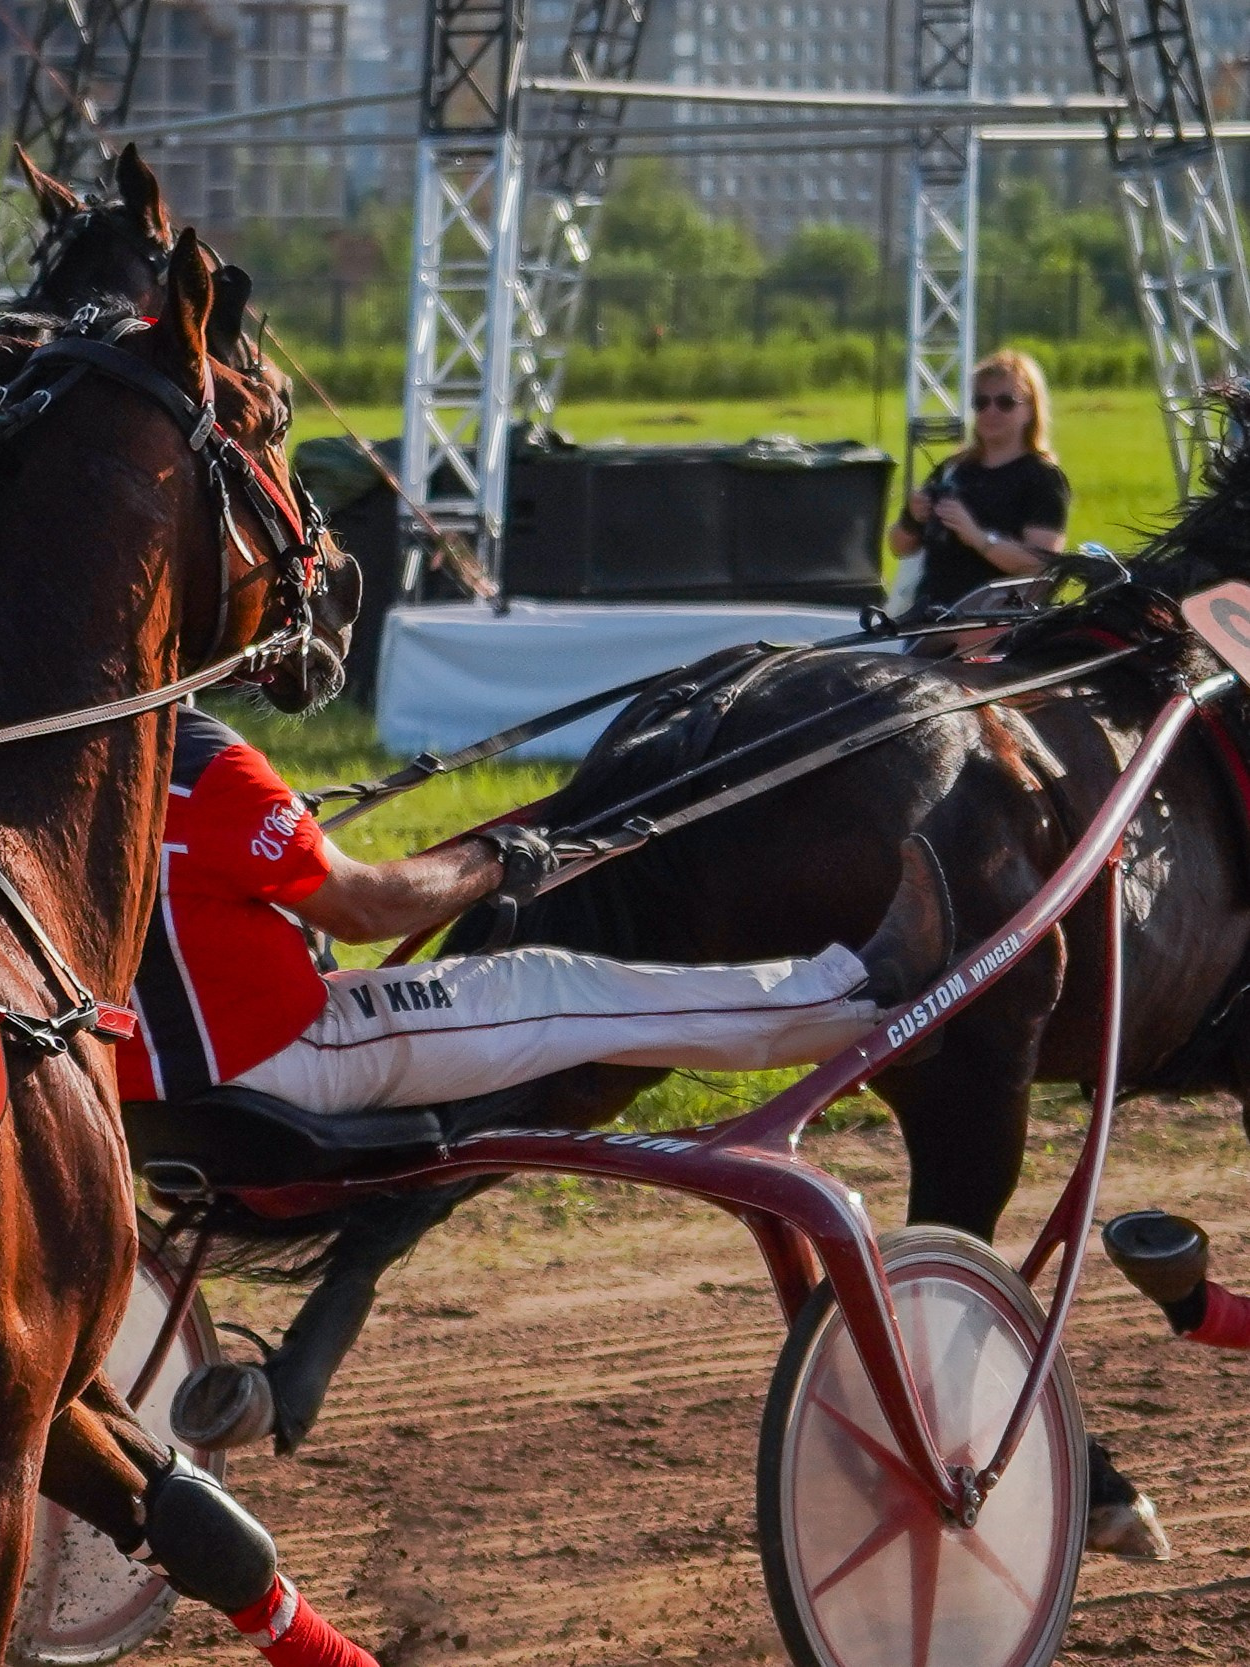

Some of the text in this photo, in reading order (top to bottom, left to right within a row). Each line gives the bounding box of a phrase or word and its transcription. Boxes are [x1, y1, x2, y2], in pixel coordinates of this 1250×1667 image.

[349, 979, 453, 1019] V KRA
[886, 973, 967, 1049] CUSTOM
